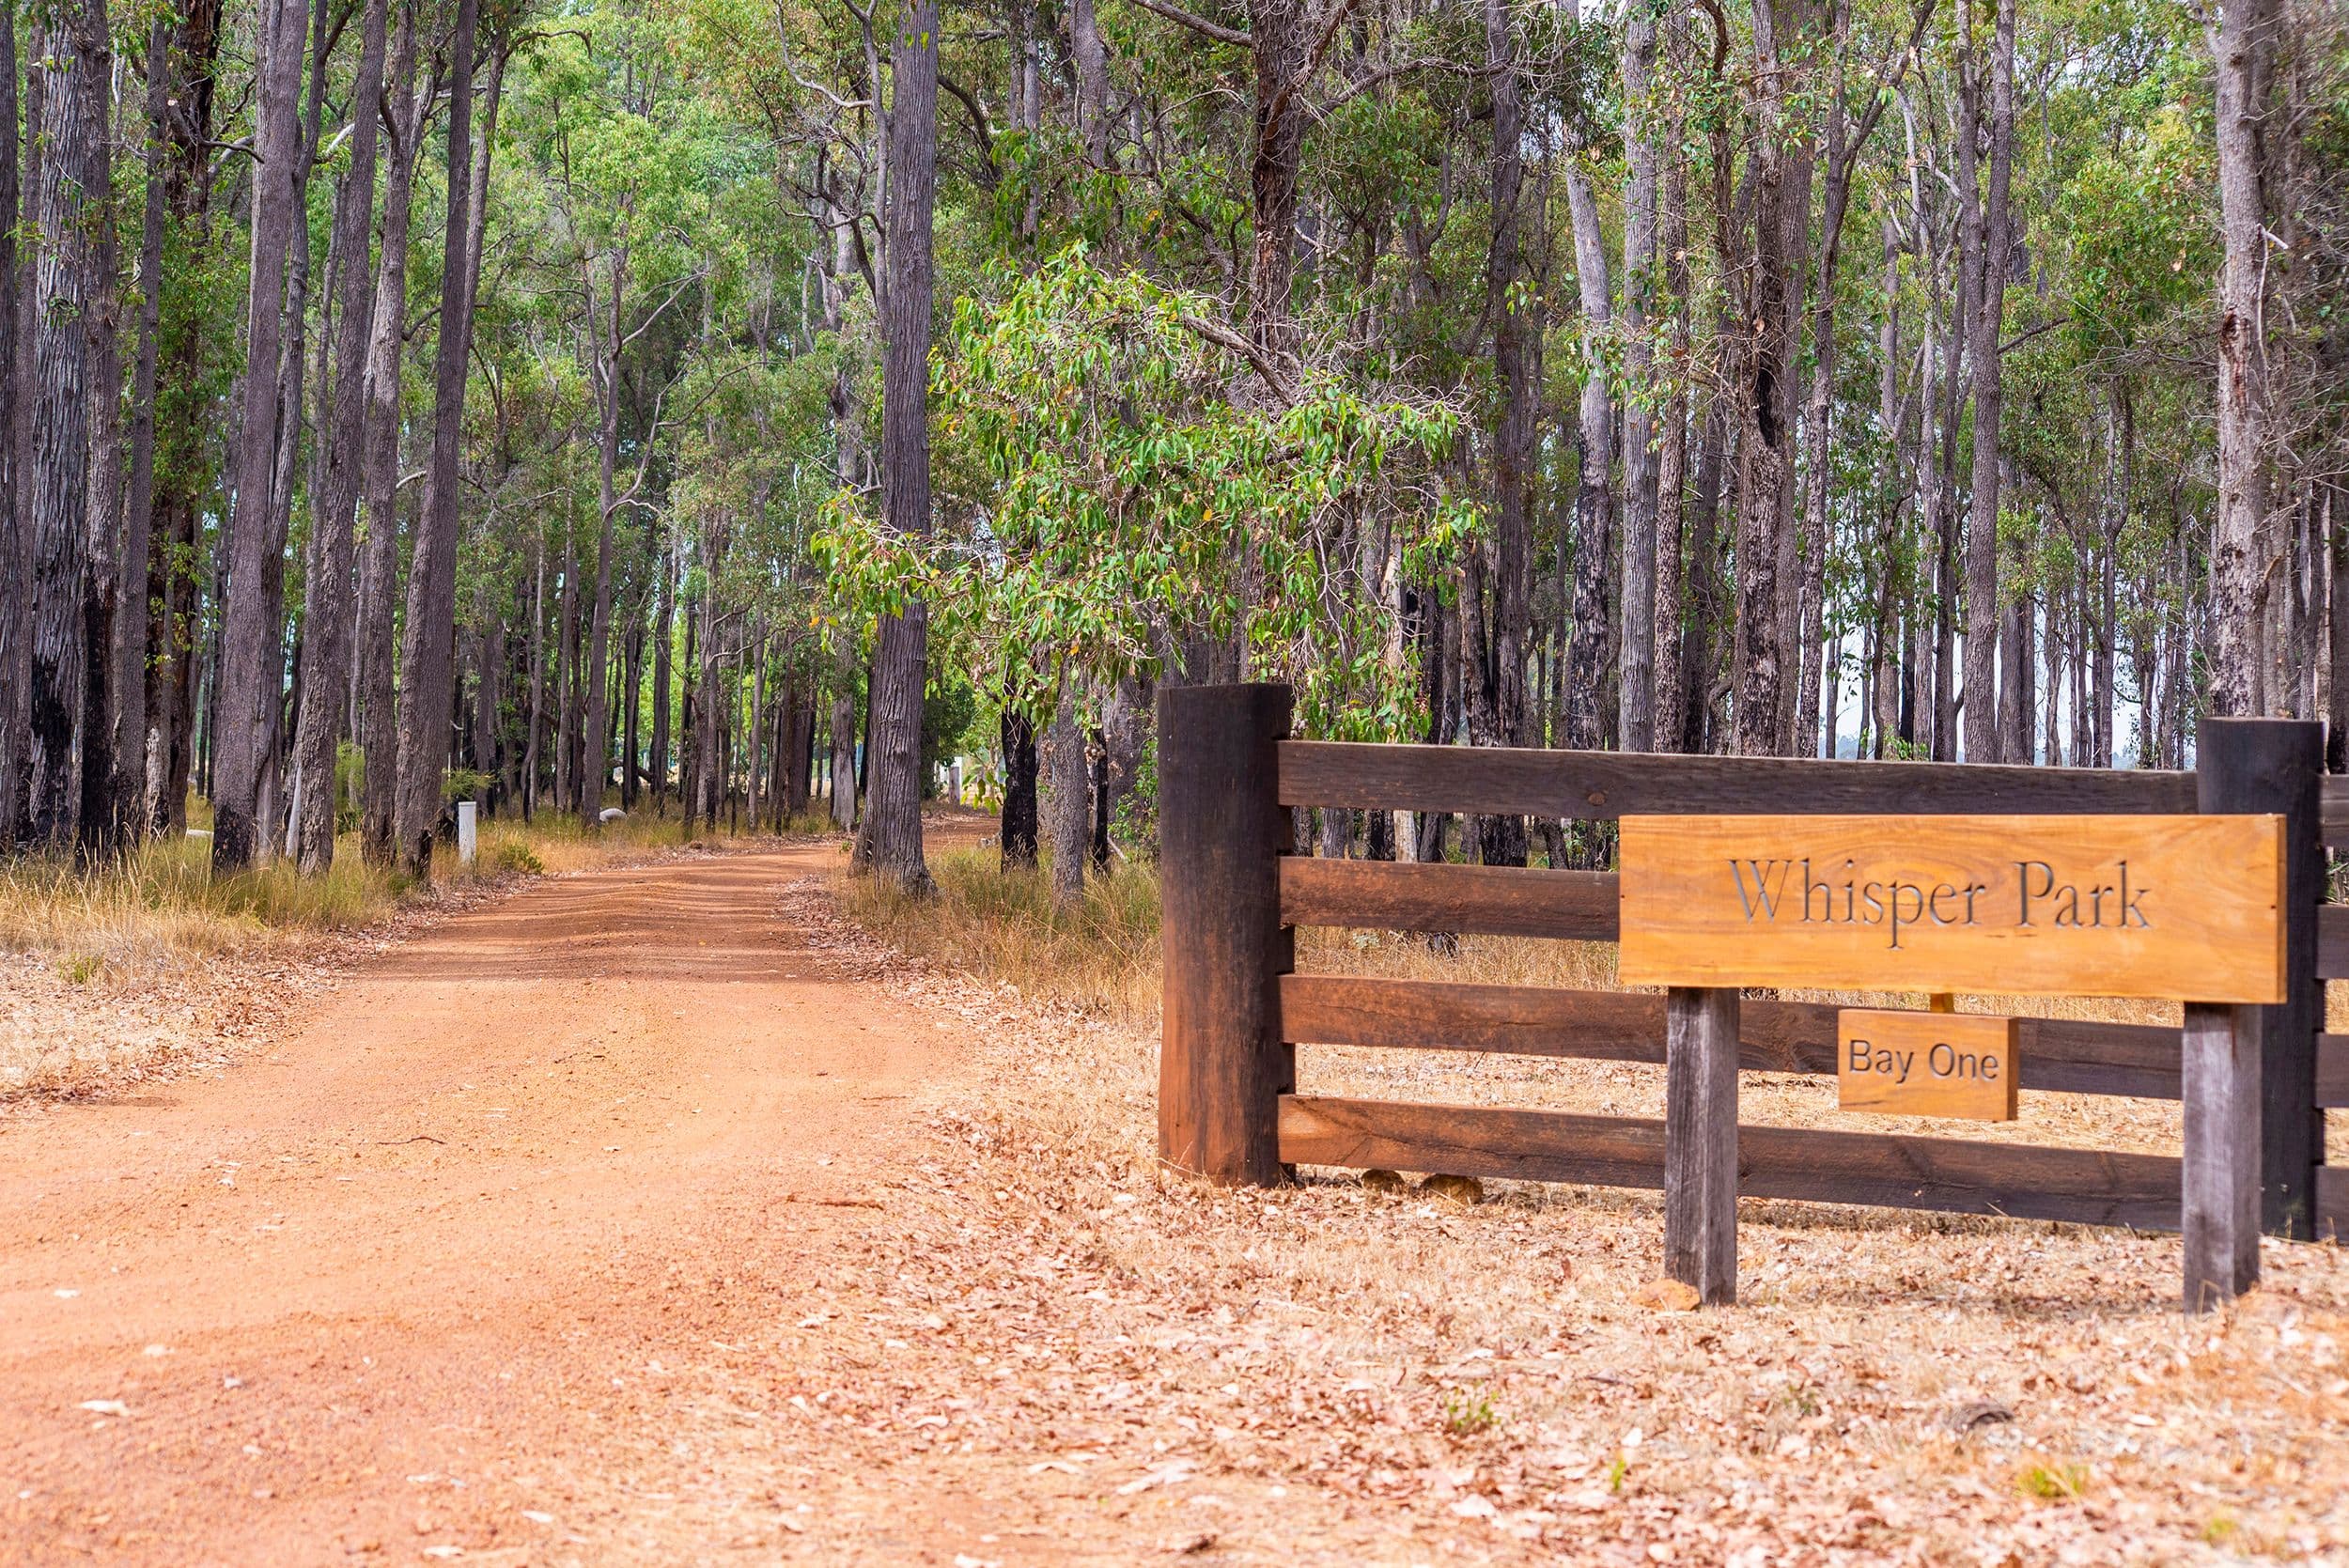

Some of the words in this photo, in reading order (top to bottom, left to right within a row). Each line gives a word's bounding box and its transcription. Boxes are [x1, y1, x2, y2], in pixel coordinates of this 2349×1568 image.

[1727, 857, 1986, 951] Whisper
[2014, 859, 2153, 930] Park
[1848, 1039, 1915, 1085] Bay
[1928, 1043, 1999, 1081] One
